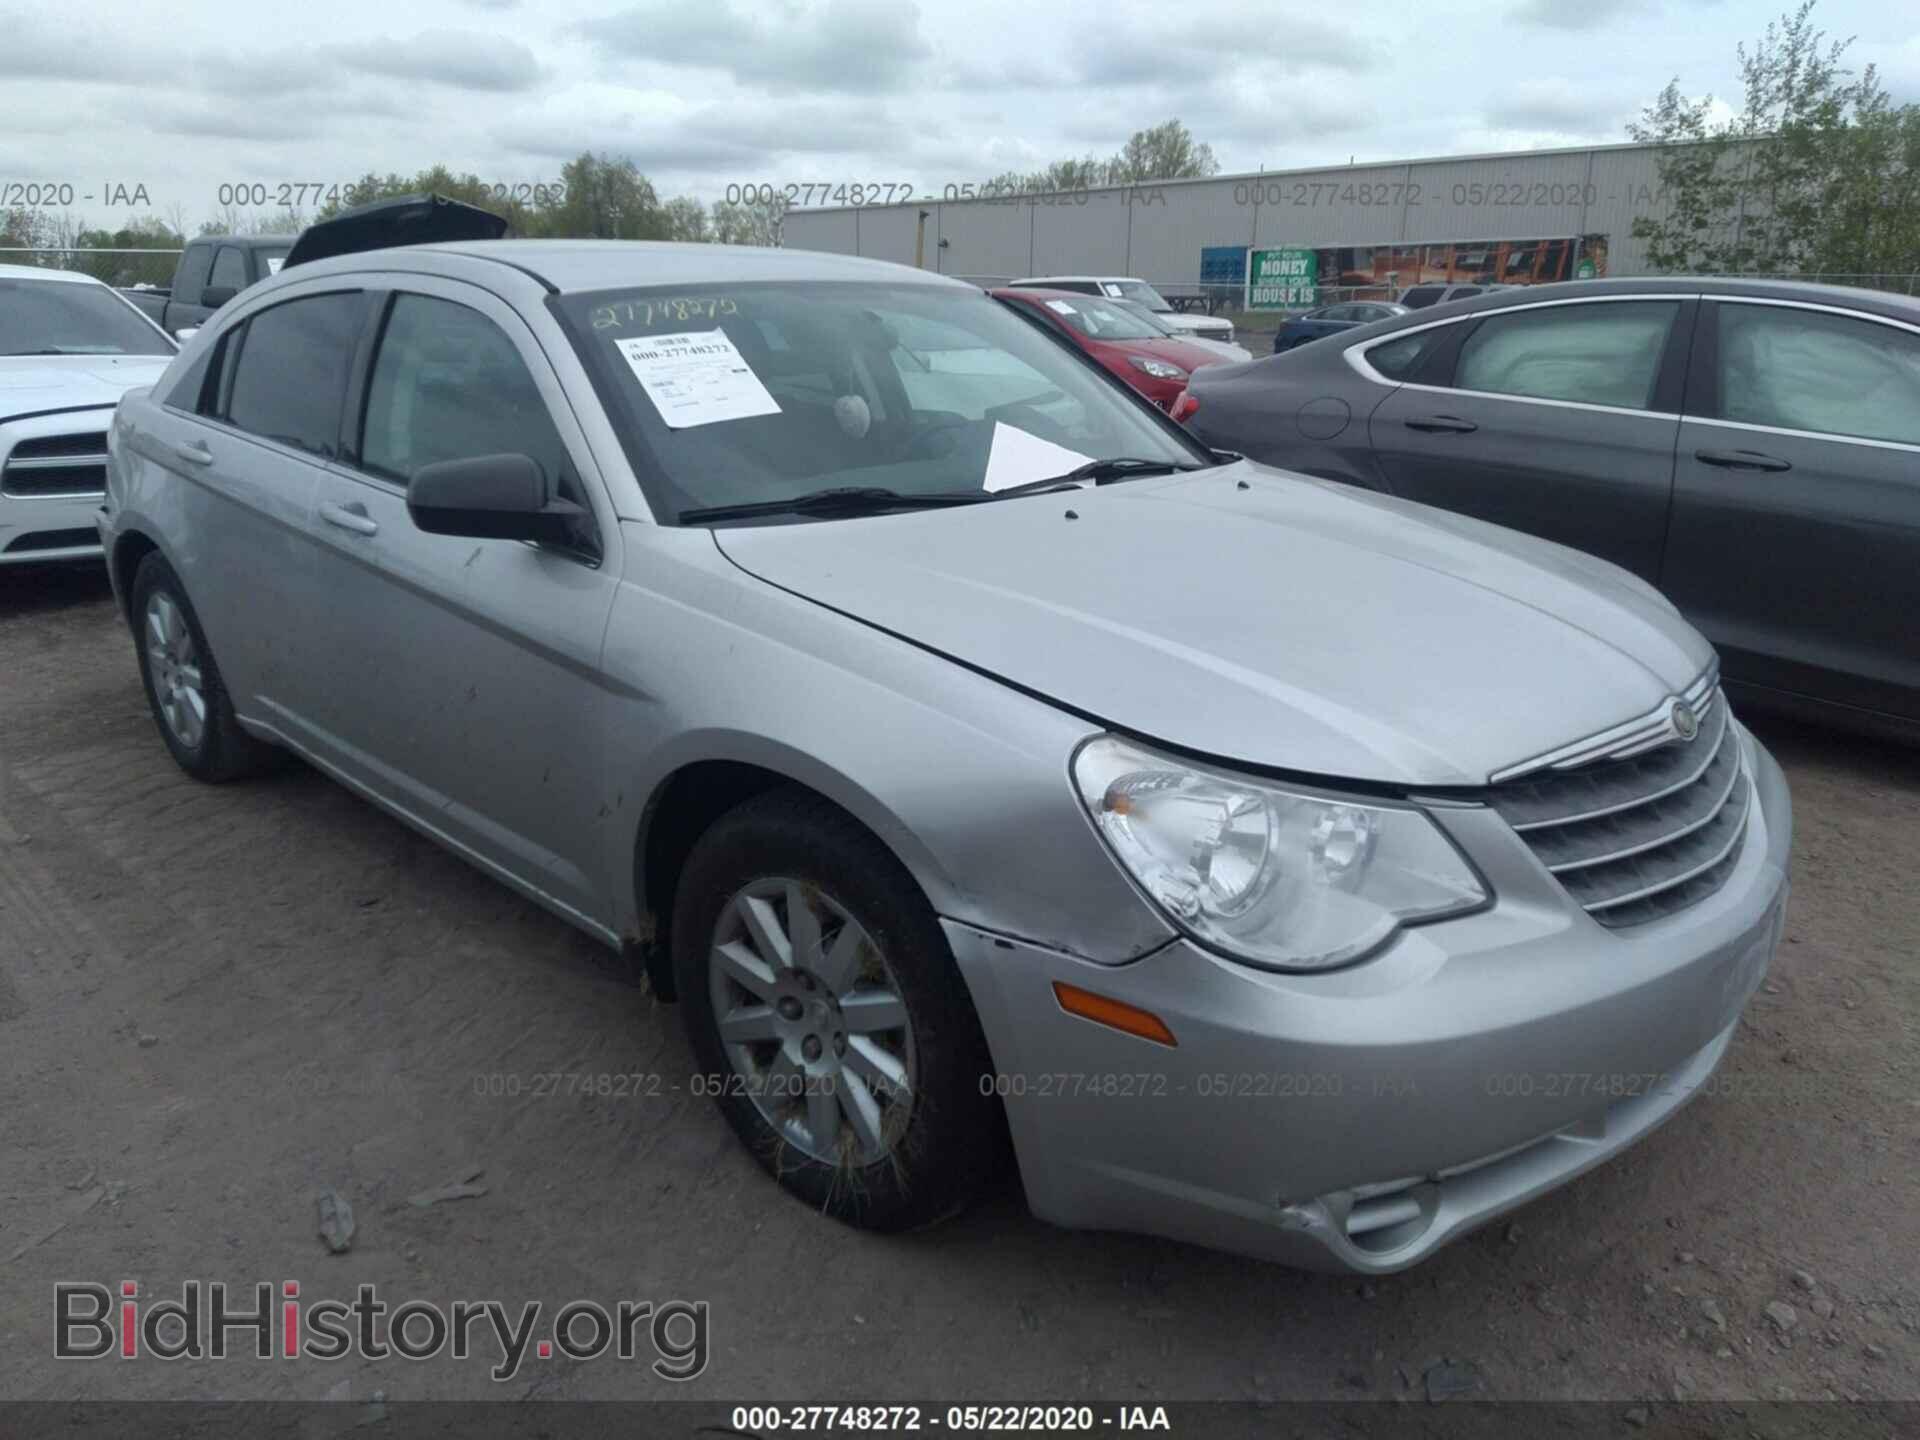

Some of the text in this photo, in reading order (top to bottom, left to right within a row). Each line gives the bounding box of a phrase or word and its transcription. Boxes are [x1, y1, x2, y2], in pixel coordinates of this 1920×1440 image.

[1260, 259, 1309, 276] MONEY
[1253, 287, 1315, 303] HOUSE IS
[631, 343, 732, 362] 000-27748272
